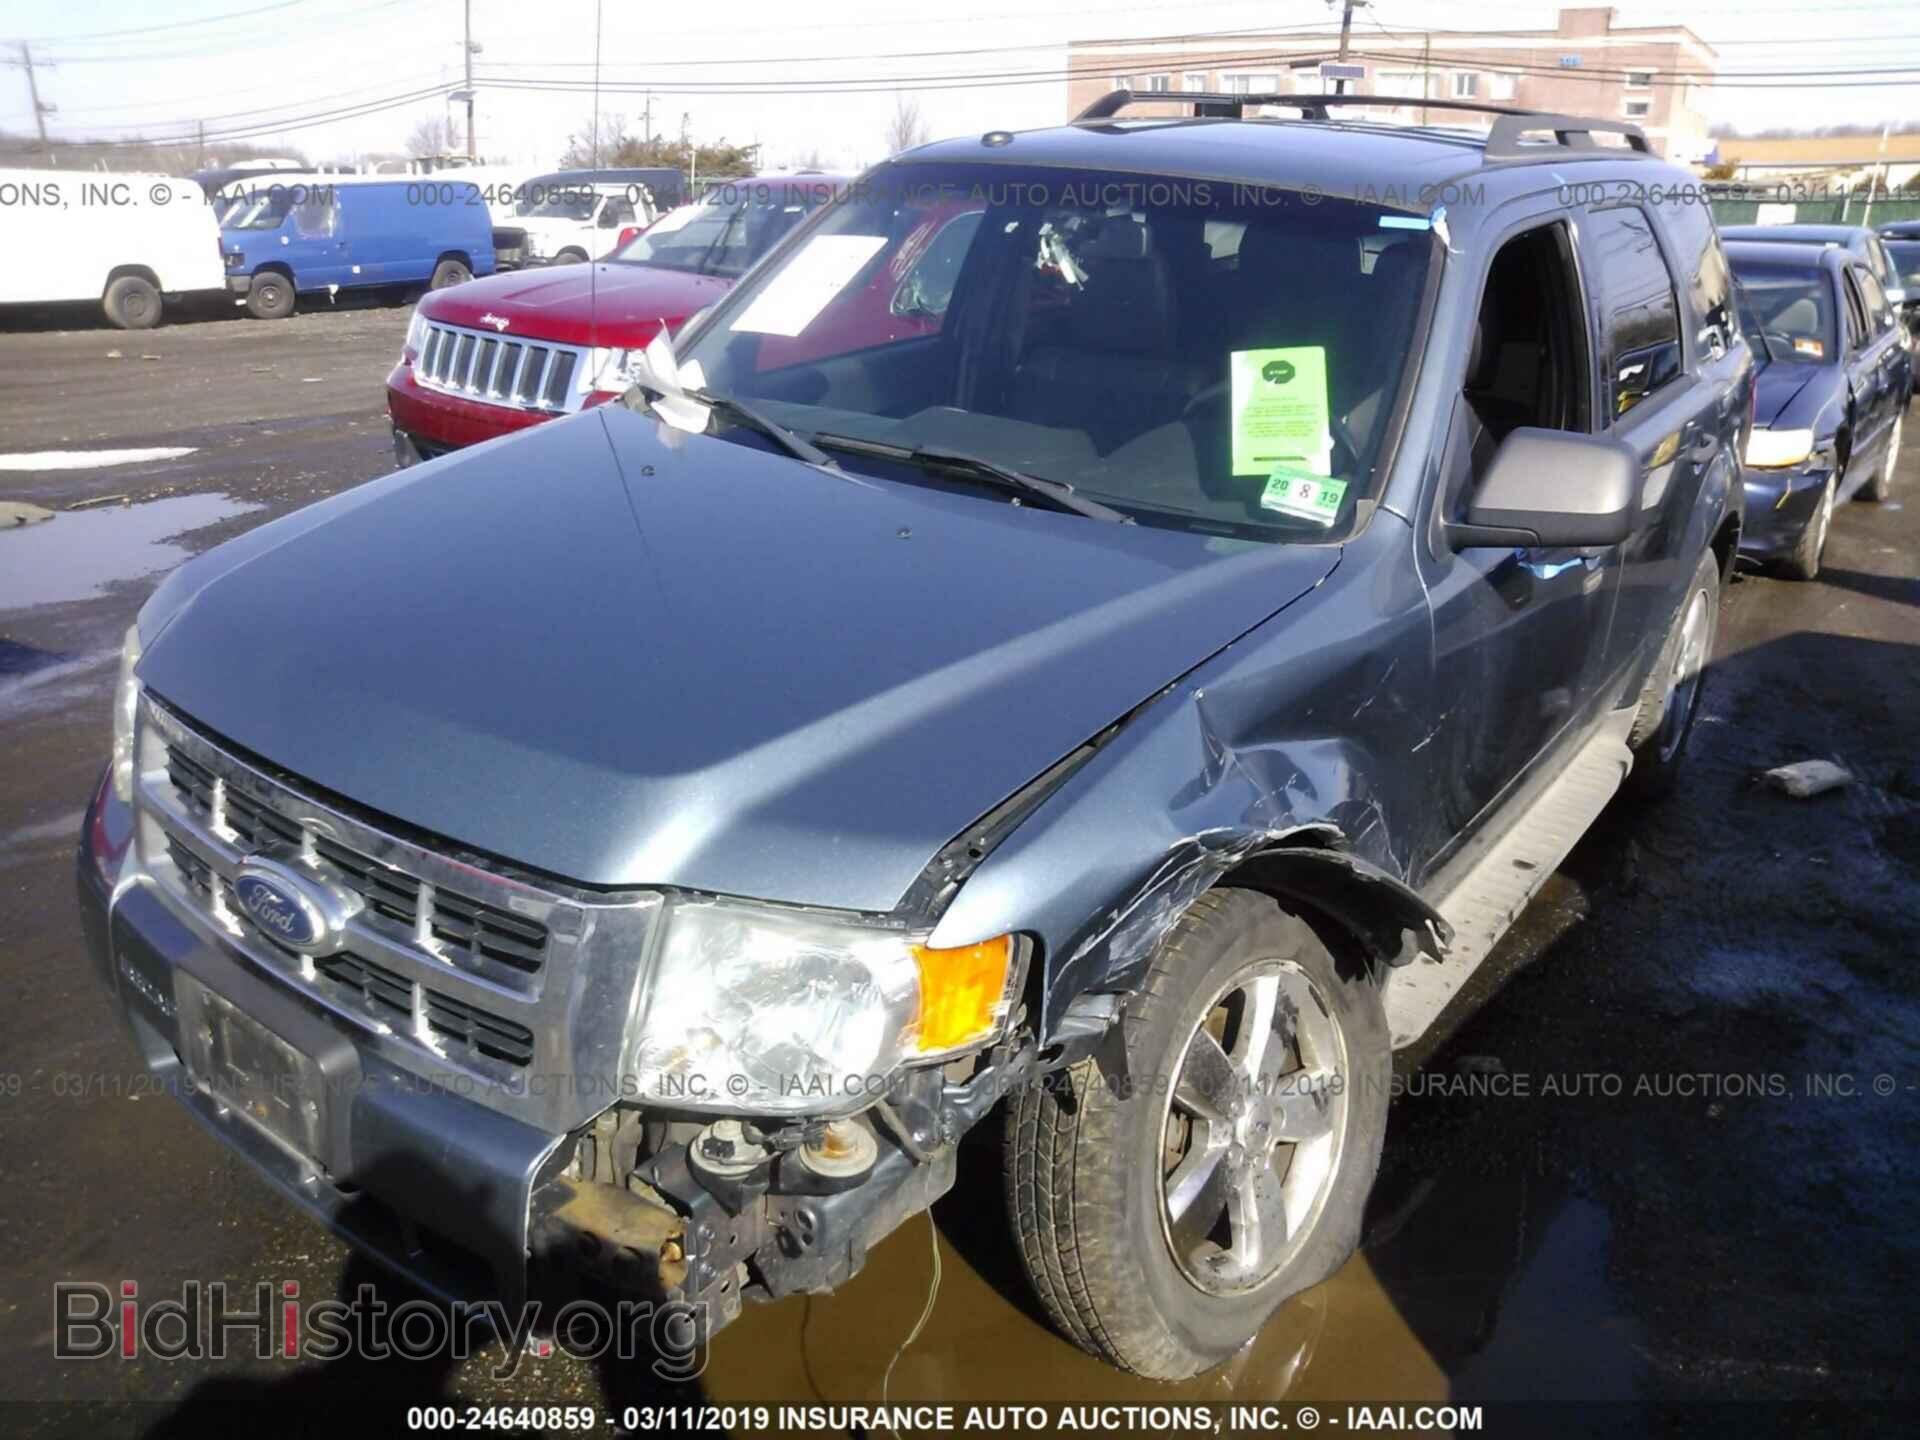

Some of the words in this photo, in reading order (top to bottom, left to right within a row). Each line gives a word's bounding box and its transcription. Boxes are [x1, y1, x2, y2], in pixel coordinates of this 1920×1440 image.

[1271, 477, 1290, 492] 20
[1320, 490, 1339, 504] 19
[248, 883, 295, 933] Ford
